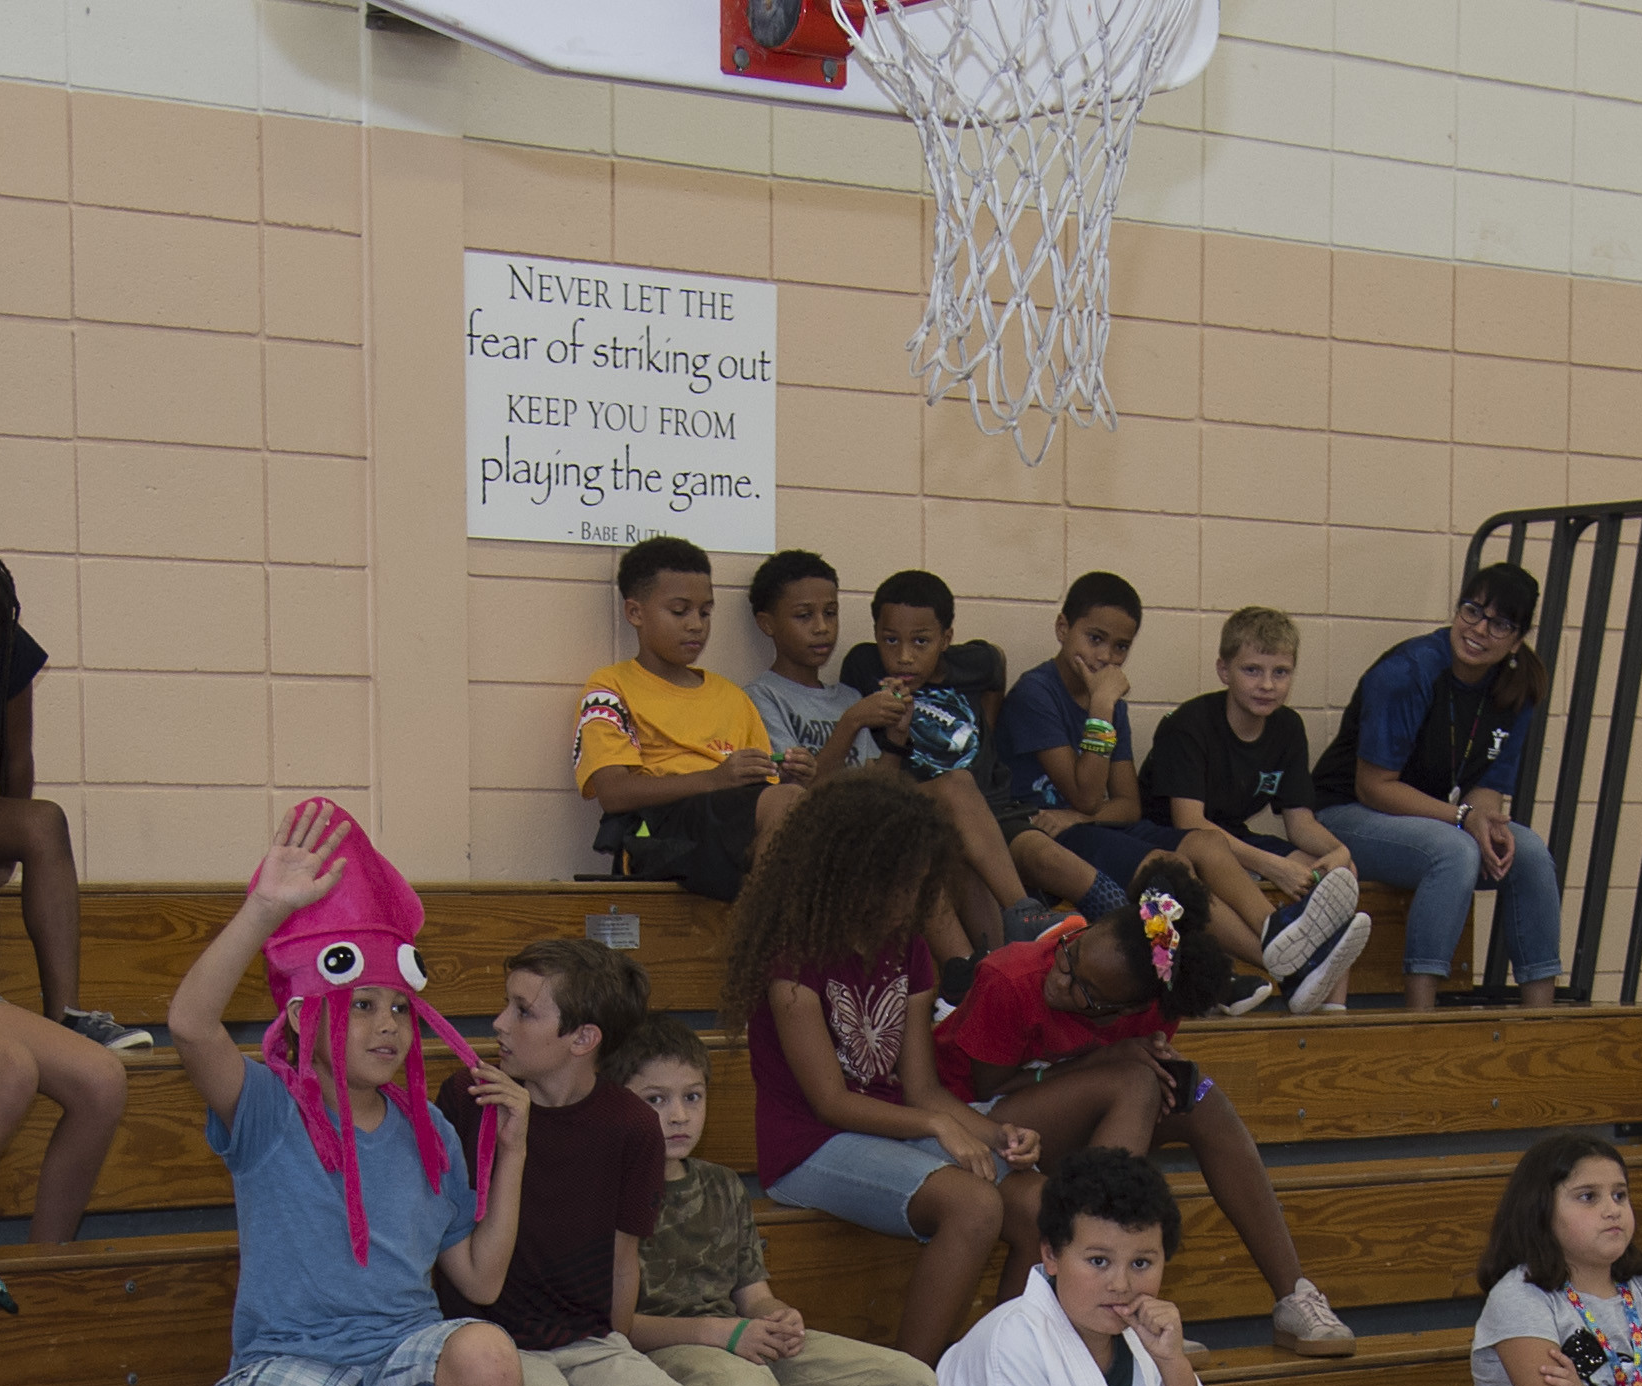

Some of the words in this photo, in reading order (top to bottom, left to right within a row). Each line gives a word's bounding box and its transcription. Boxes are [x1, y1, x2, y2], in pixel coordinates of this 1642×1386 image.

[507, 263, 612, 310] NEVER
[623, 282, 672, 316] LET
[680, 288, 735, 322] THE
[466, 307, 538, 360] fear
[546, 317, 586, 365] of
[593, 324, 712, 395] striking
[718, 350, 772, 382] out
[507, 394, 578, 427] KEEP
[588, 400, 648, 433] YOU
[659, 407, 737, 441] FROM
[481, 435, 605, 507] playing
[611, 443, 663, 493] the
[669, 470, 761, 513] game.
